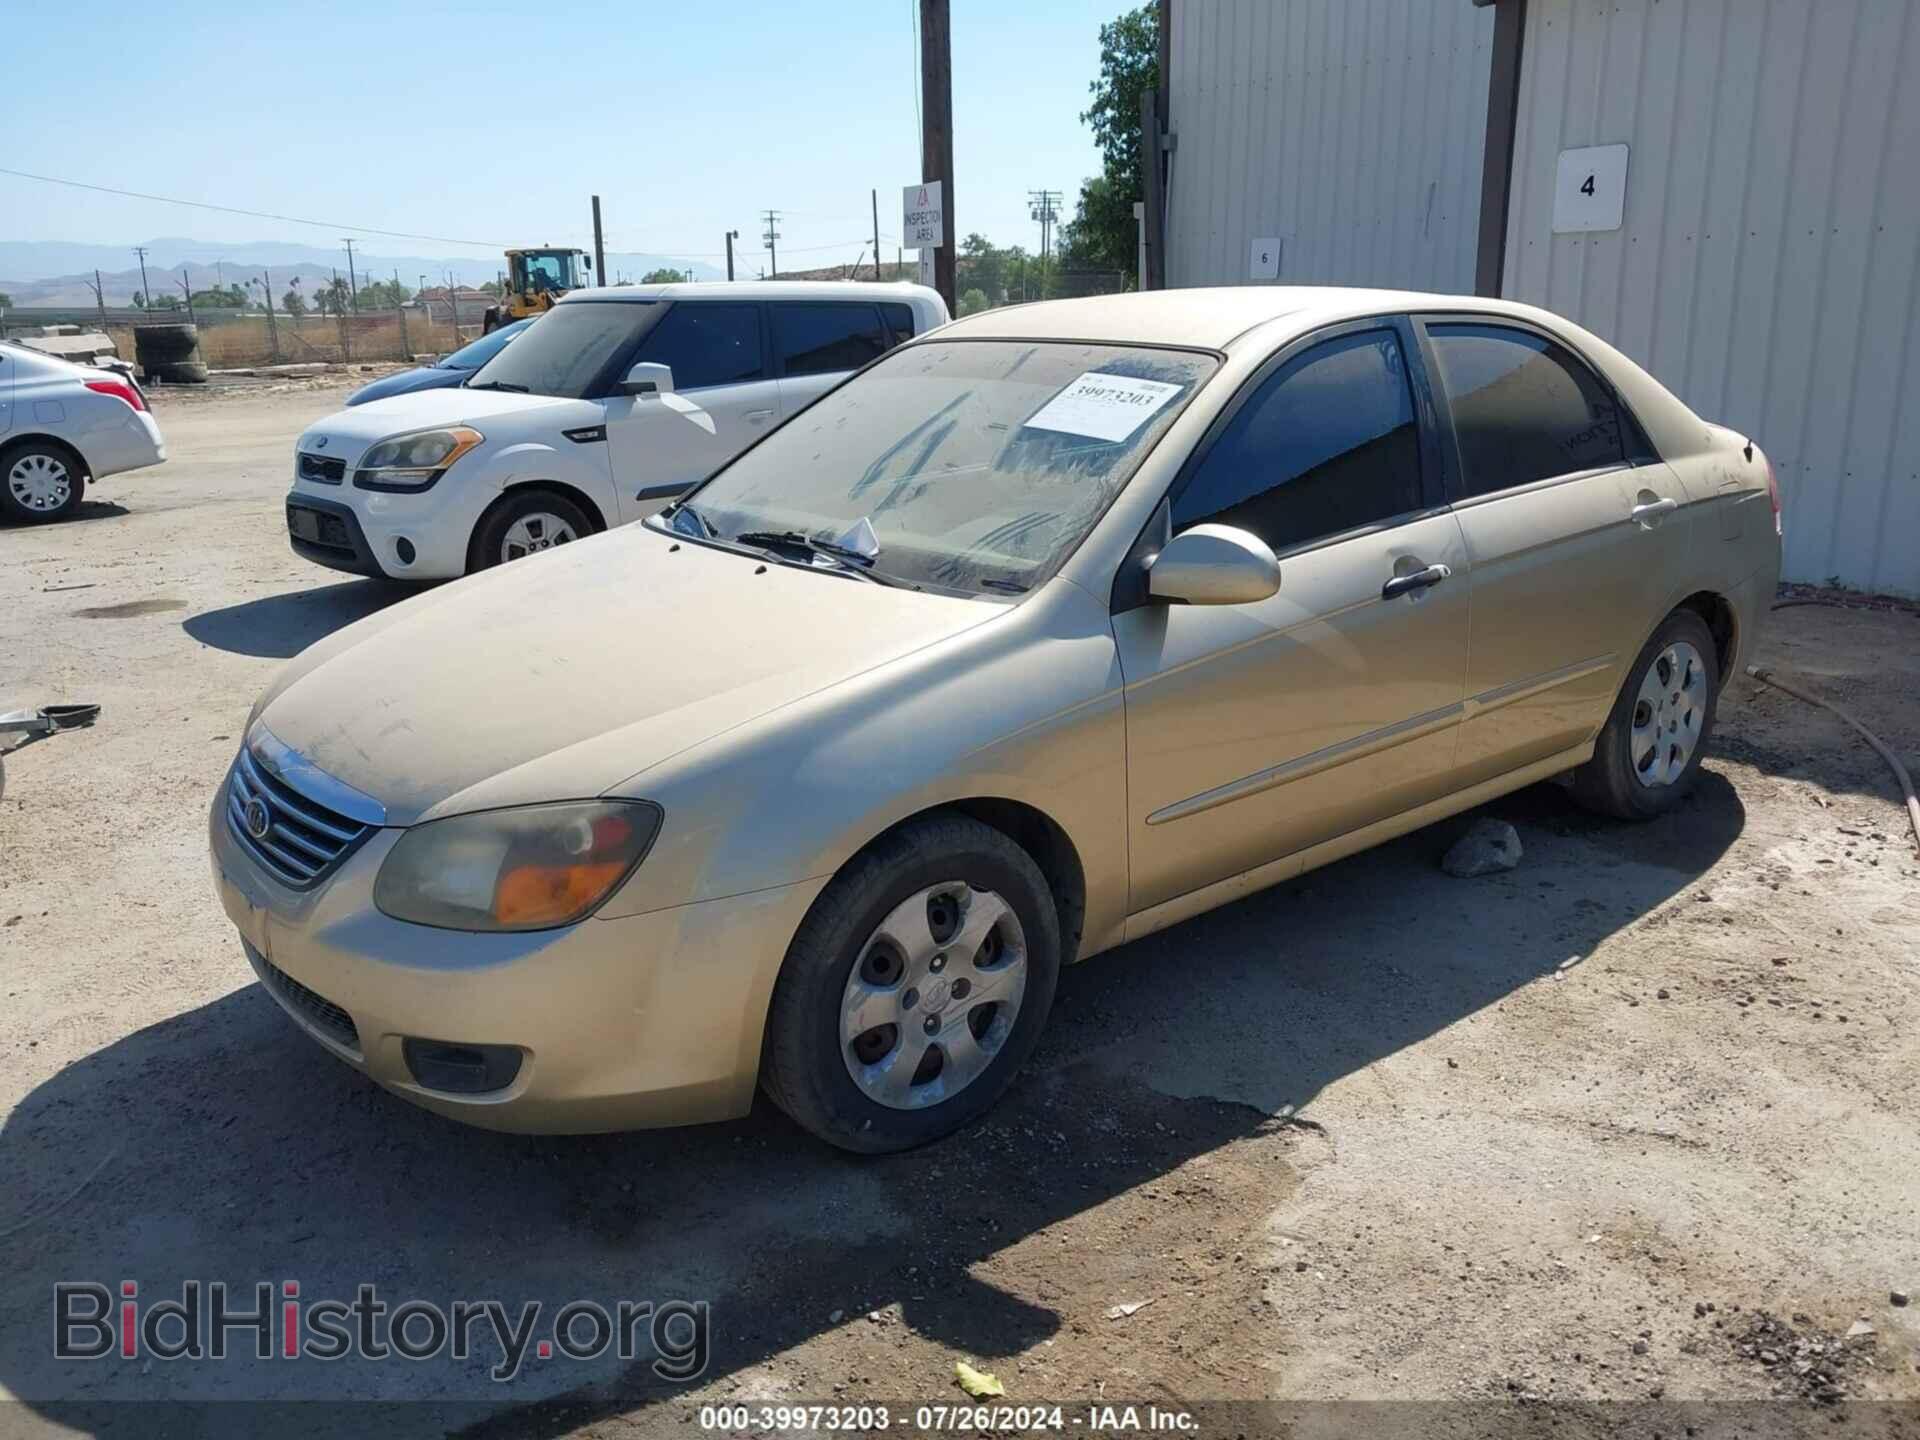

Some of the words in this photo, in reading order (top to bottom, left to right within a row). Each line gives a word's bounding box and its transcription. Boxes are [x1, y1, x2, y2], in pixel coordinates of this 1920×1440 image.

[1580, 175, 1595, 197] 4
[904, 210, 942, 227] INSPECTION
[916, 227, 935, 242] AREA
[1261, 252, 1268, 263] 6
